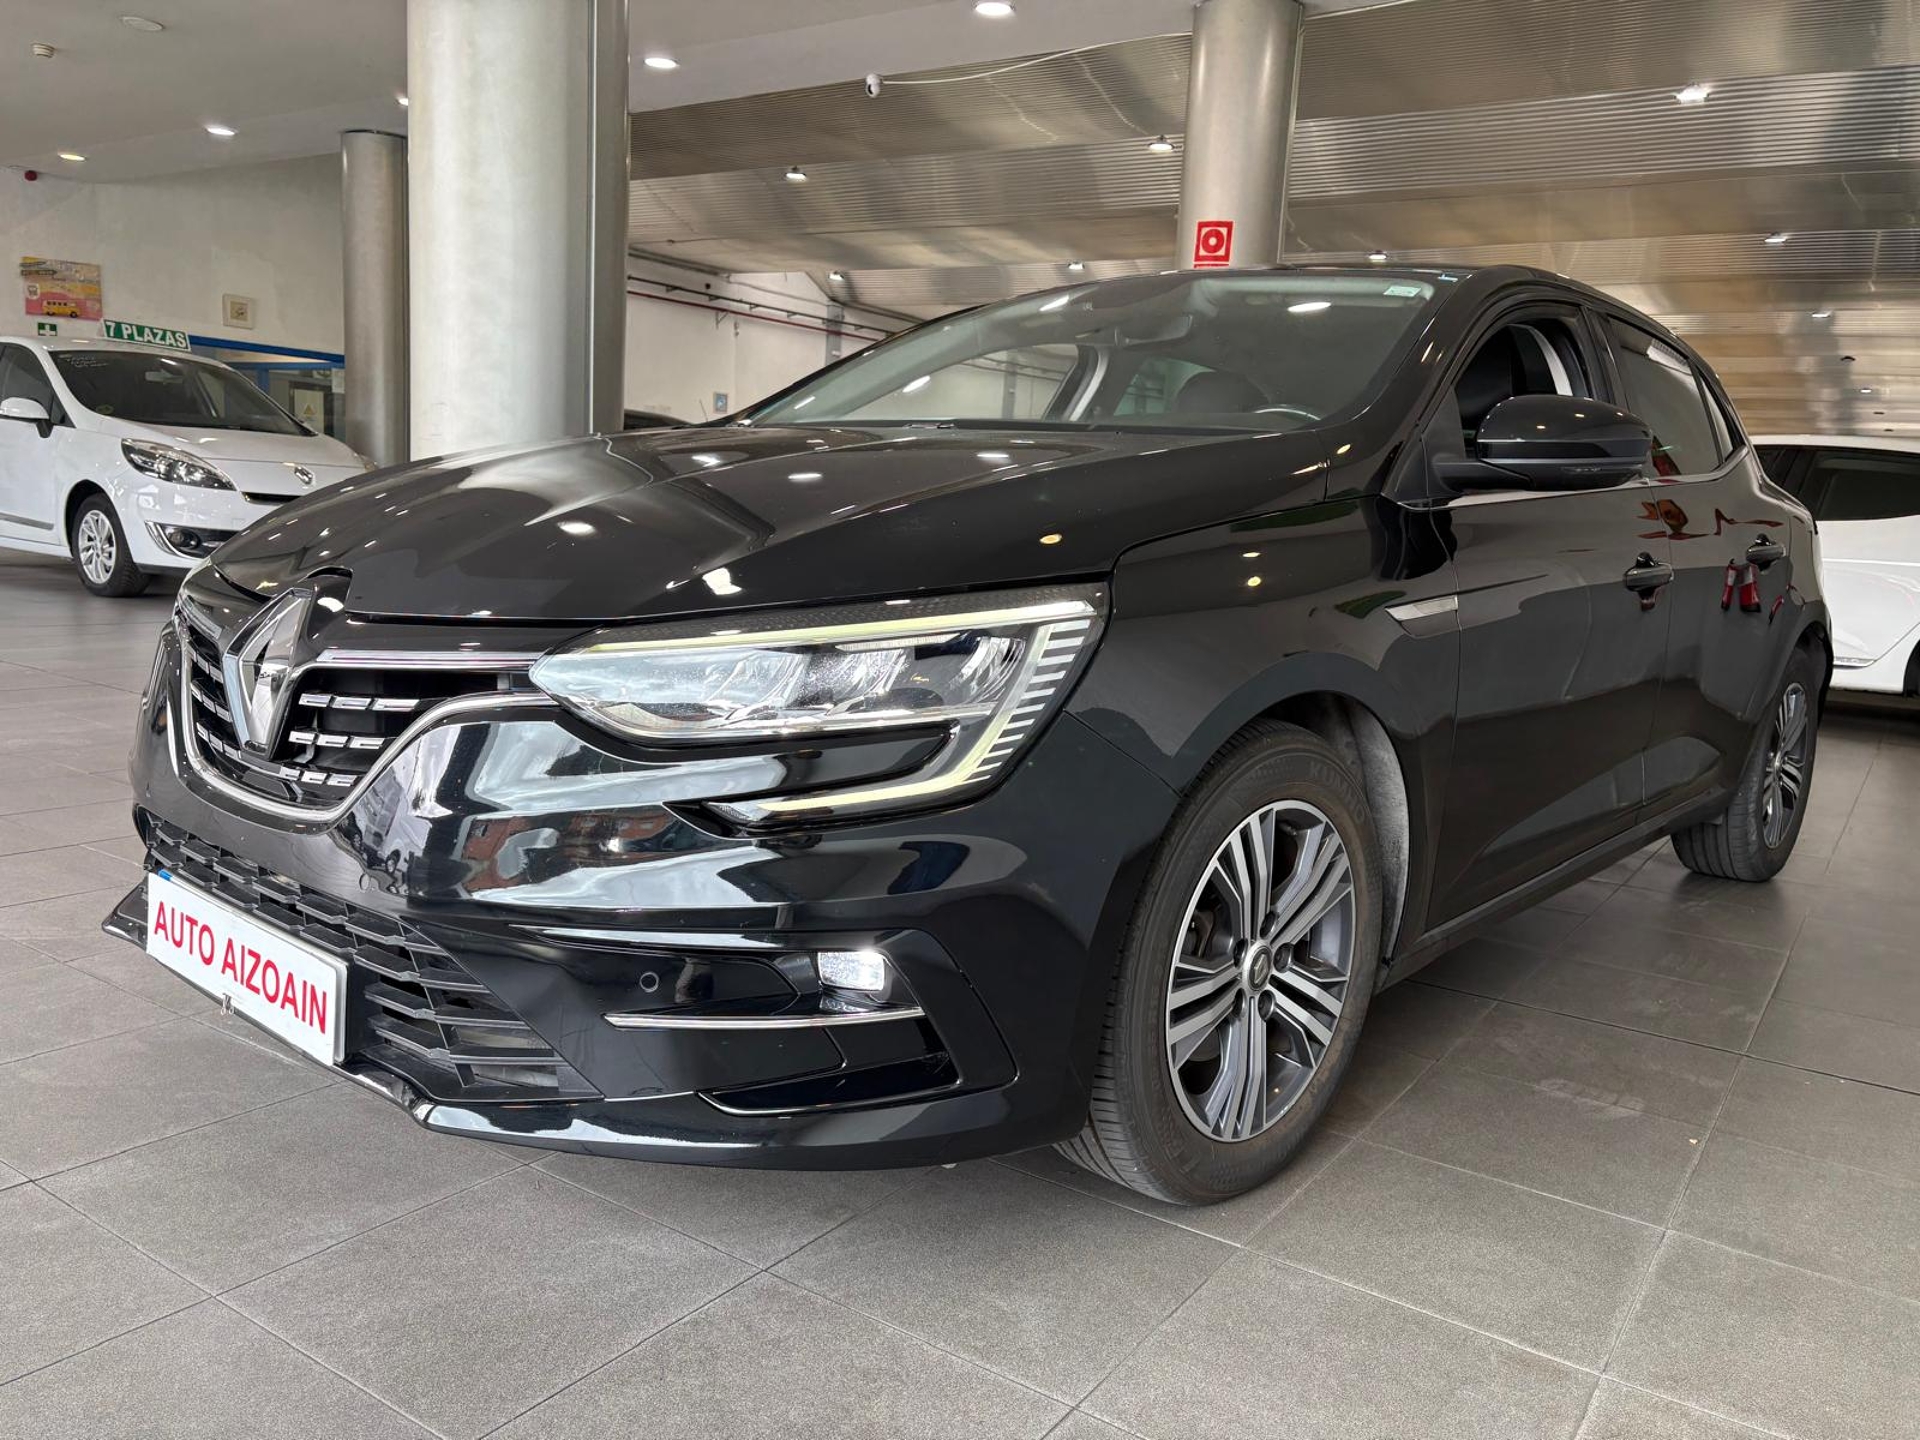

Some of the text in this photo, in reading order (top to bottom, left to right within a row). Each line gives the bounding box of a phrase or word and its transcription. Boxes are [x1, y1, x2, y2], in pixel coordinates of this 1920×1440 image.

[105, 321, 187, 348] 7 PLAZAS
[154, 901, 328, 1035] AUTO AIZOAIN
